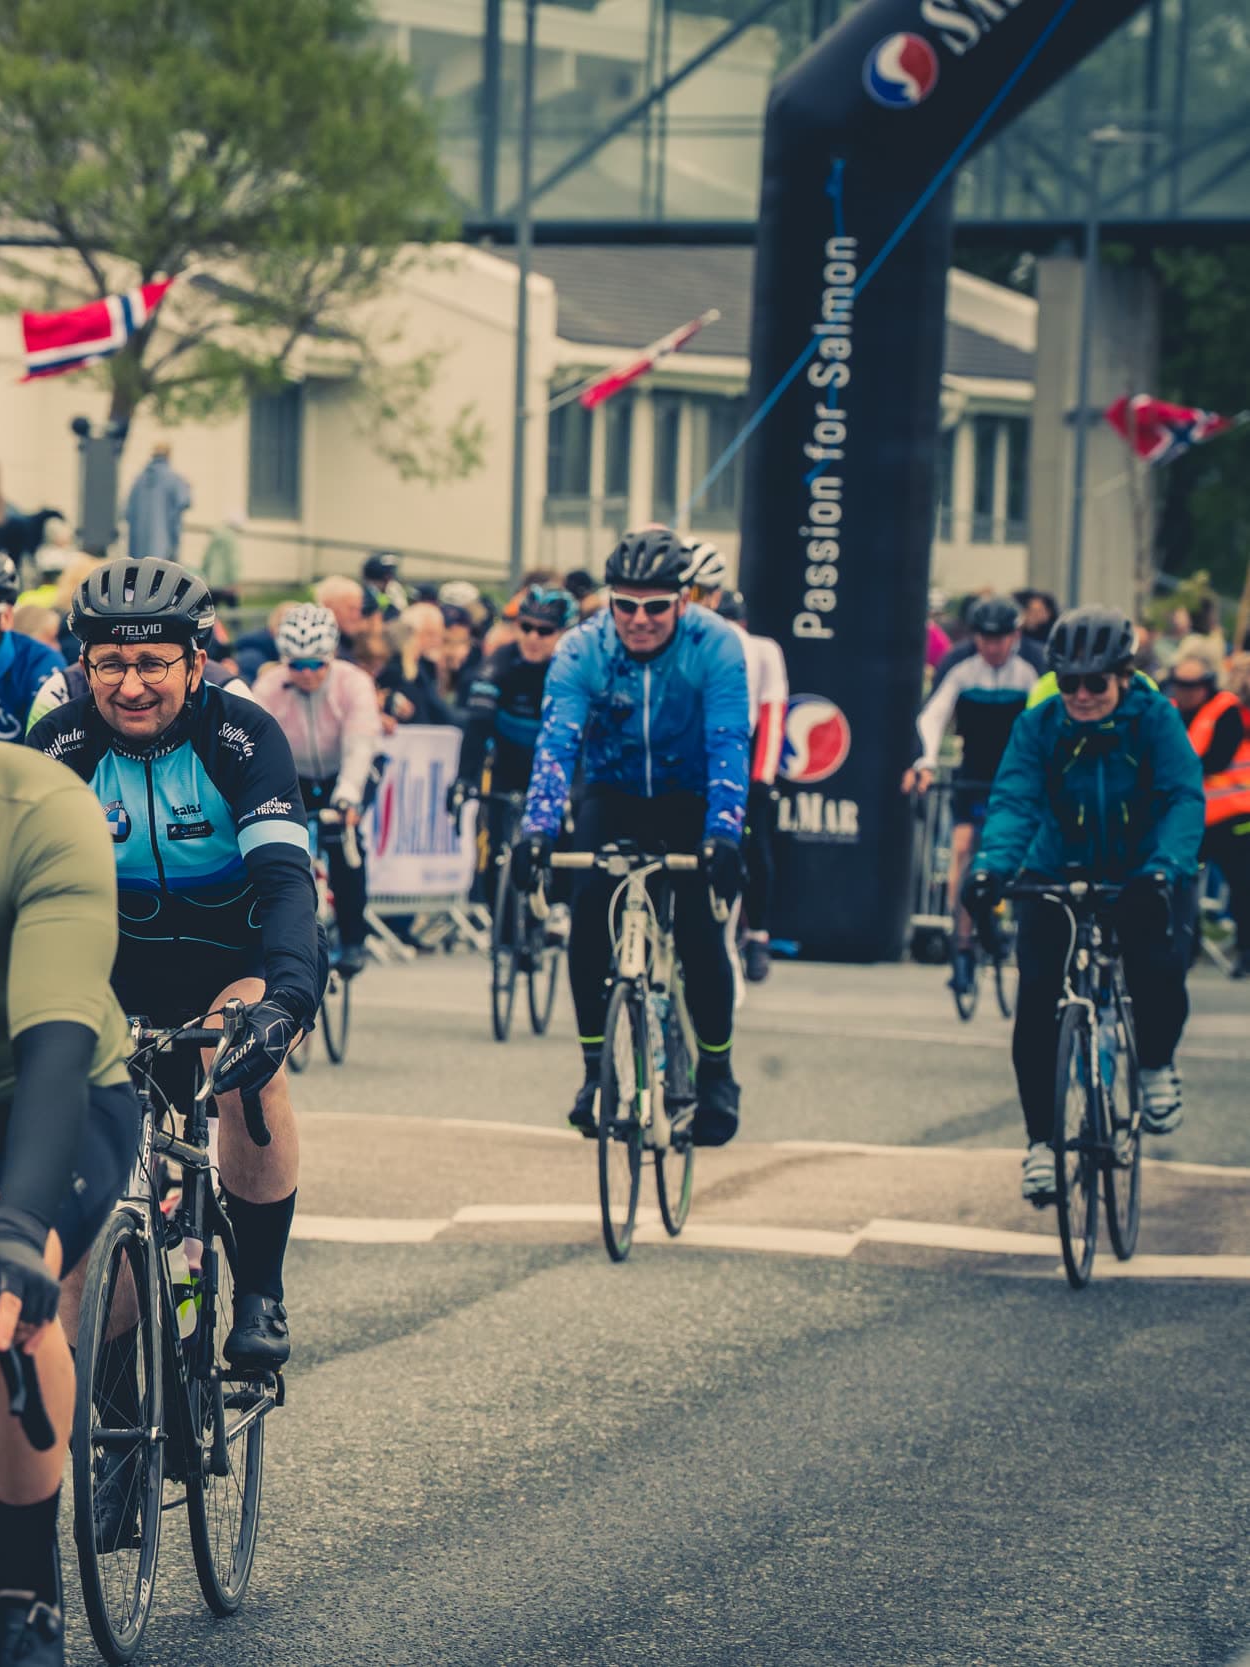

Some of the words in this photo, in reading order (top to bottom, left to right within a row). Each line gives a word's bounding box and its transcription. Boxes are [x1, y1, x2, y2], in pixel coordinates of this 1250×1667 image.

[807, 235, 858, 388] Salmon
[803, 402, 848, 460] for
[792, 476, 844, 639] Passion
[777, 792, 858, 835] LMAR
